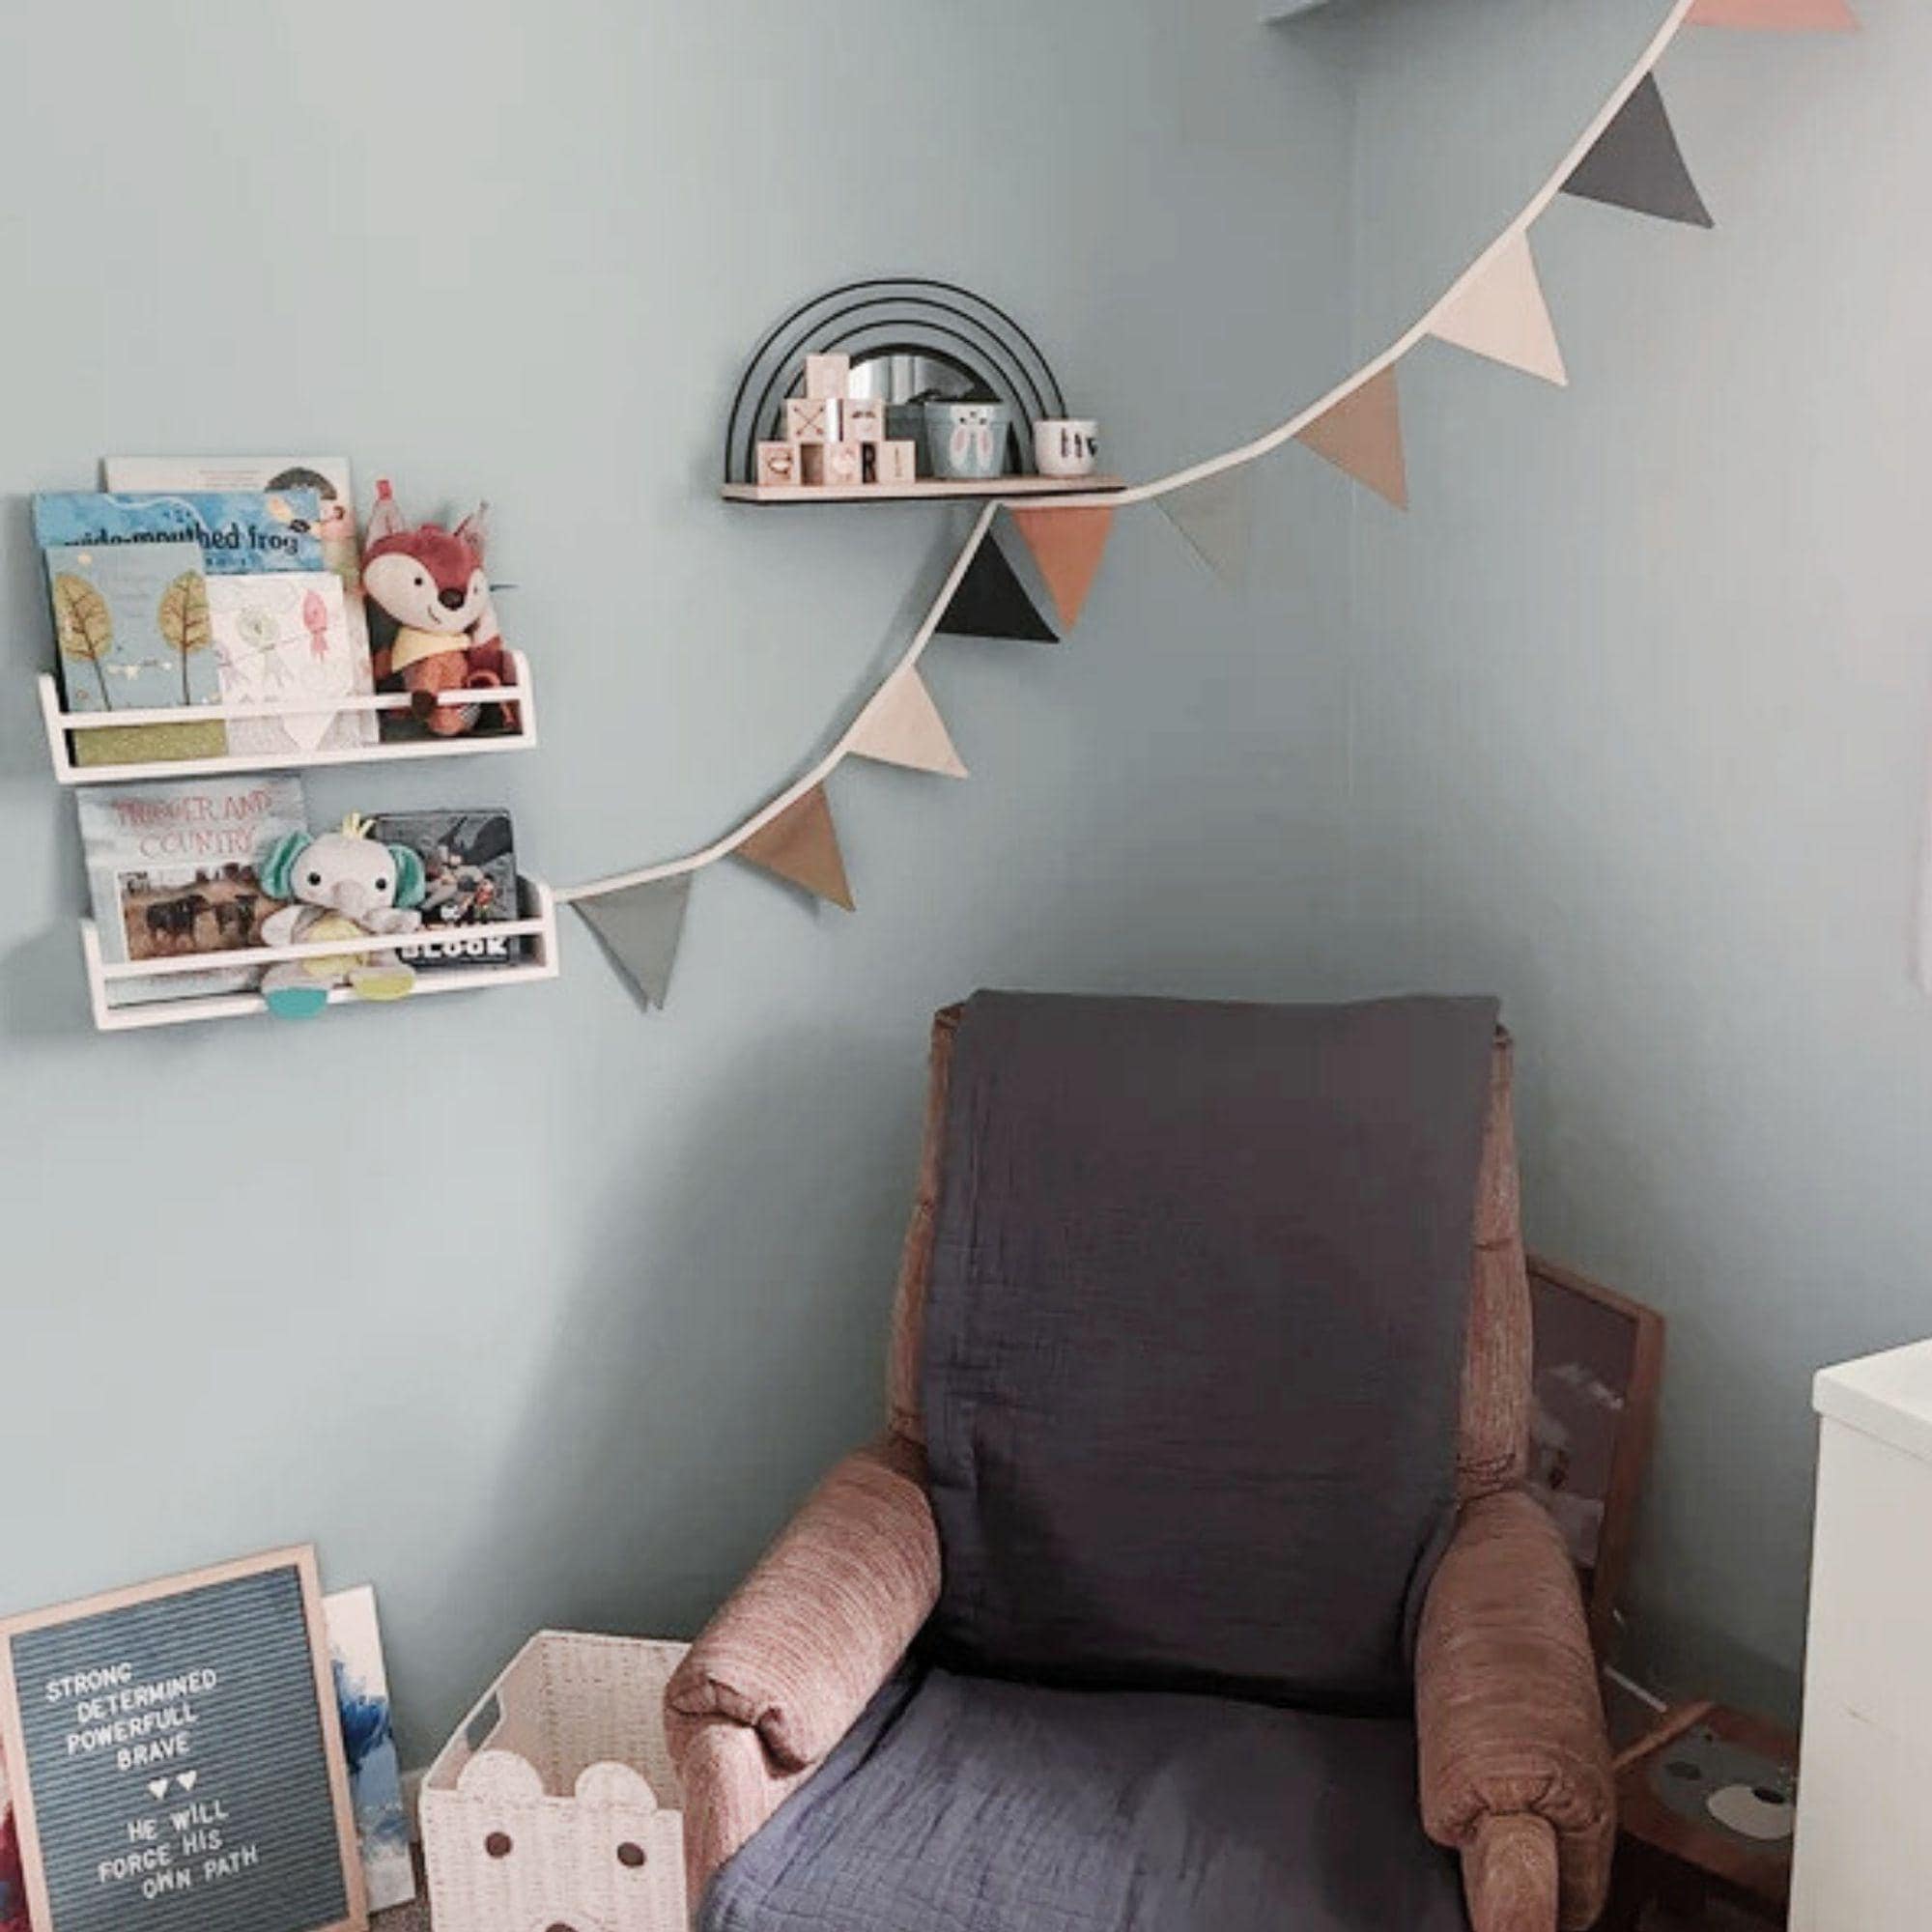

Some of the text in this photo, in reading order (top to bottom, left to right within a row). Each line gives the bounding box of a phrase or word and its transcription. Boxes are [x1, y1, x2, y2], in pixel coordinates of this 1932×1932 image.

[248, 526, 298, 554] frog
[223, 790, 271, 820] AND
[140, 826, 256, 859] COUNTRY
[45, 1662, 132, 1702] STRONG
[77, 1668, 216, 1723] DETERMINED
[68, 1702, 199, 1755] POWERFULL
[117, 1731, 190, 1771] BRAVE
[128, 1800, 229, 1842] HE WILL
[98, 1829, 223, 1883] FORGE HIS
[142, 1844, 259, 1899] OWN PATH
